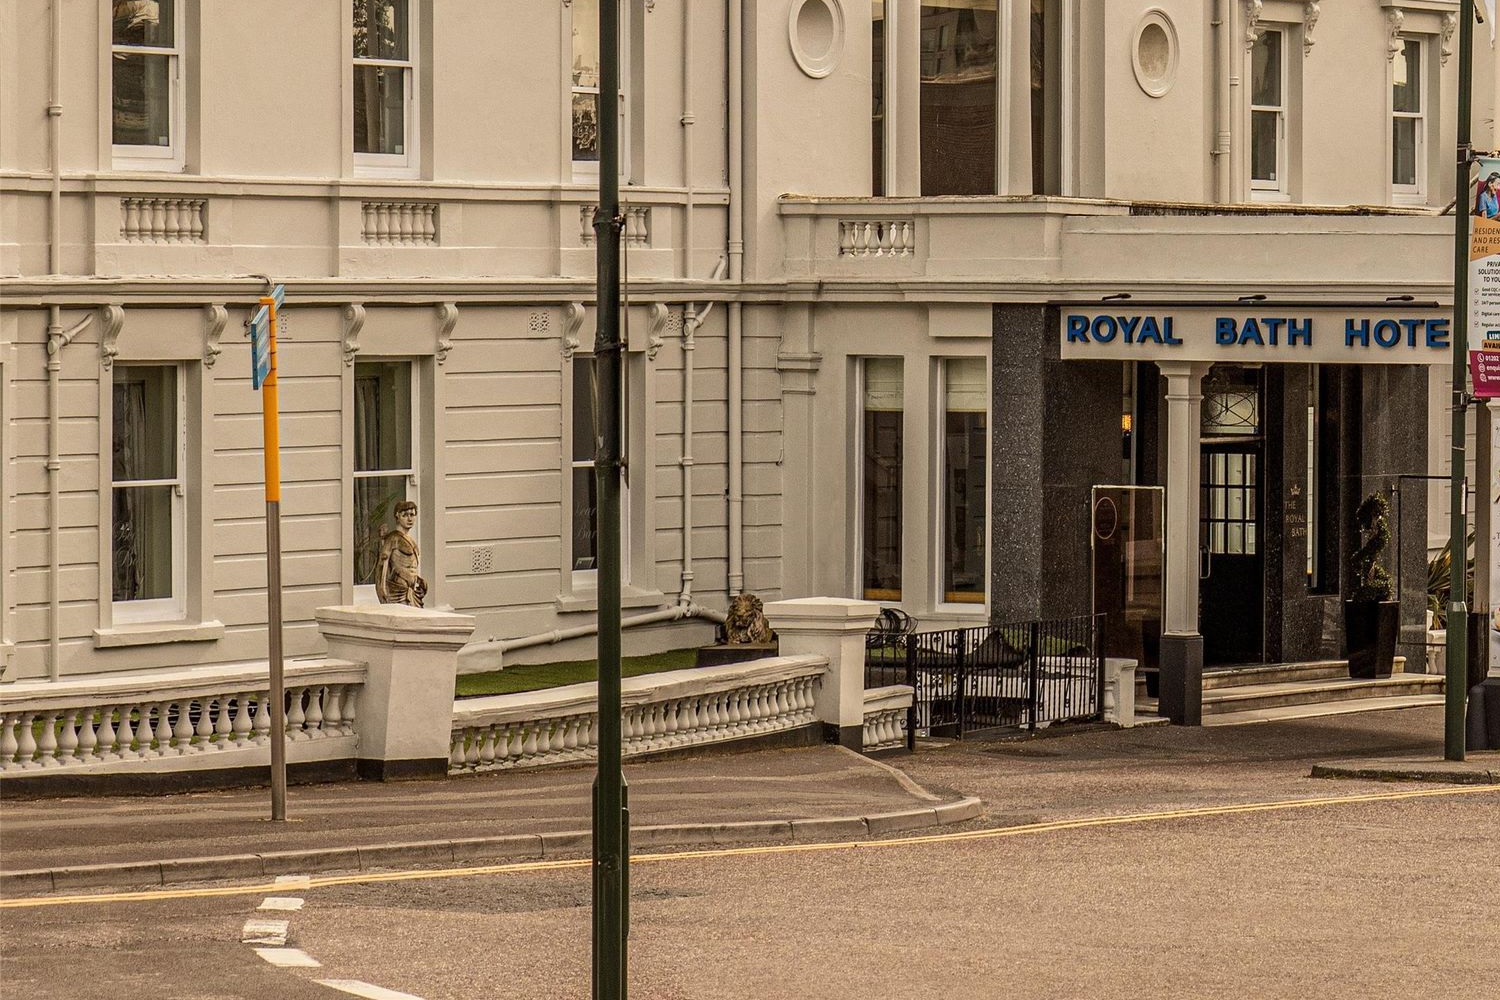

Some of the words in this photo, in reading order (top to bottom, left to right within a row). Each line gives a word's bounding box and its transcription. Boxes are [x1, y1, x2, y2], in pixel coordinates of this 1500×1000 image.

[1472, 246, 1489, 254] CARE
[1066, 315, 1183, 345] ROYAL
[1215, 316, 1312, 346] BATH
[1345, 318, 1450, 348] HOTE
[1284, 500, 1297, 510] THE
[1285, 514, 1305, 523] ROYAL
